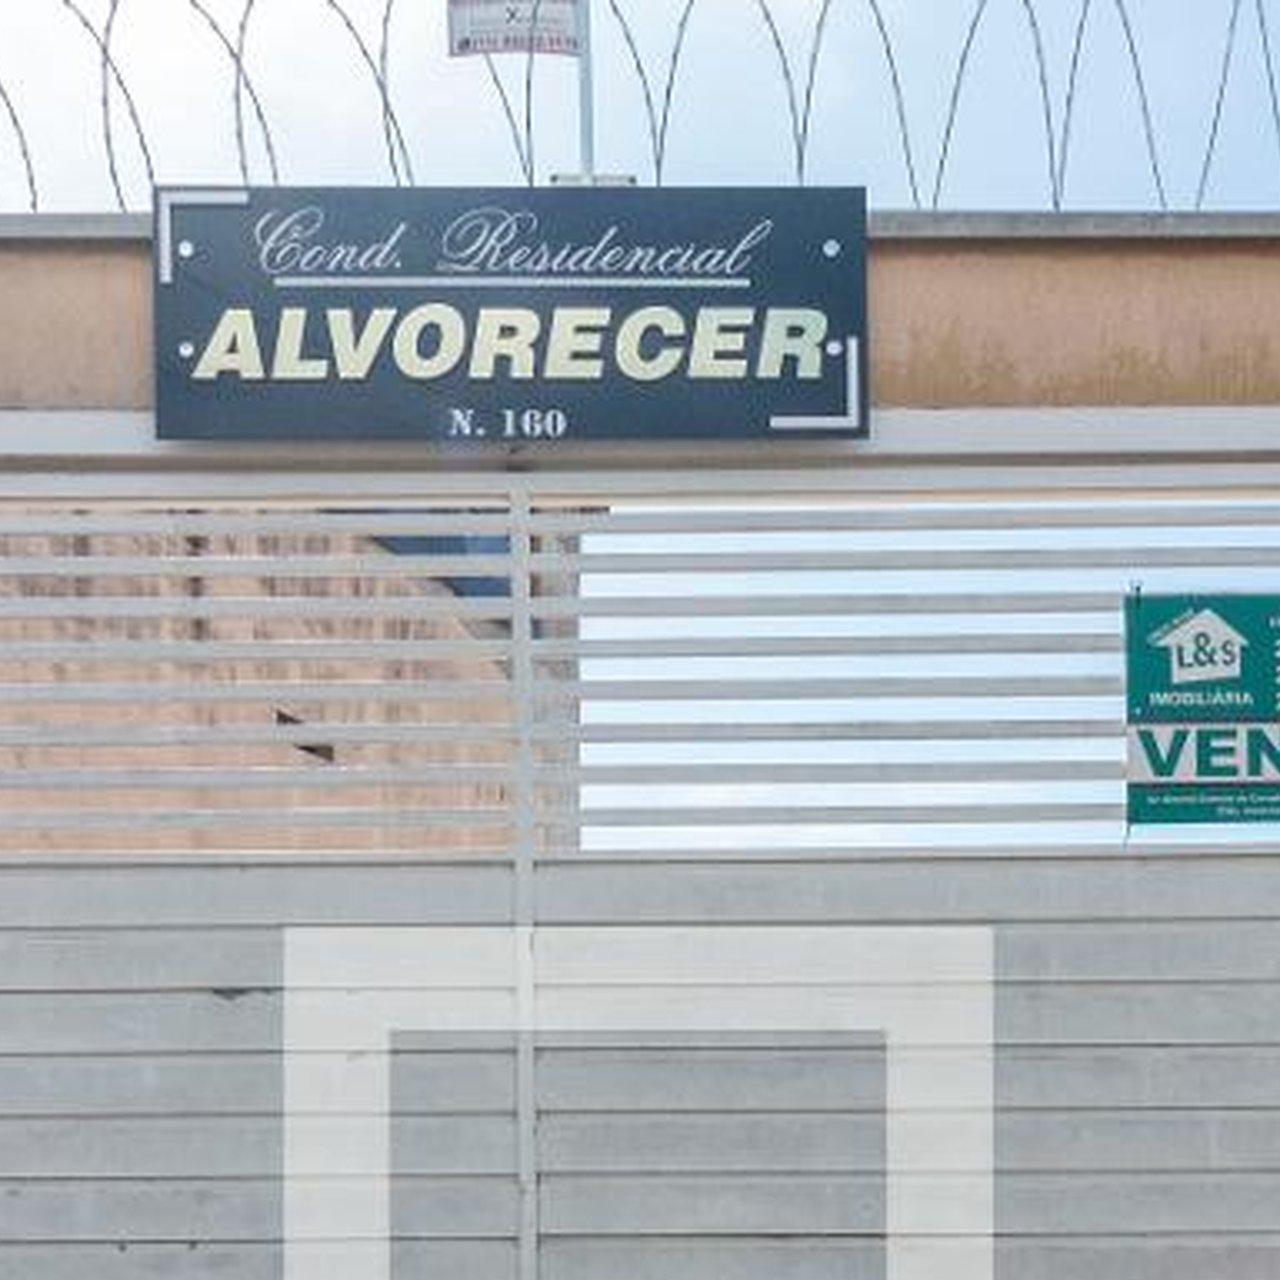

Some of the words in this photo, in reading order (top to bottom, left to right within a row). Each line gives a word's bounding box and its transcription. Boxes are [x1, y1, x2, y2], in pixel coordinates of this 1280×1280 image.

[254, 207, 402, 274] Cond.
[438, 206, 774, 276] Residencial
[191, 303, 829, 380] ALVORECER
[449, 409, 485, 436] N.
[502, 408, 568, 437] 160
[1177, 632, 1237, 668] L&S
